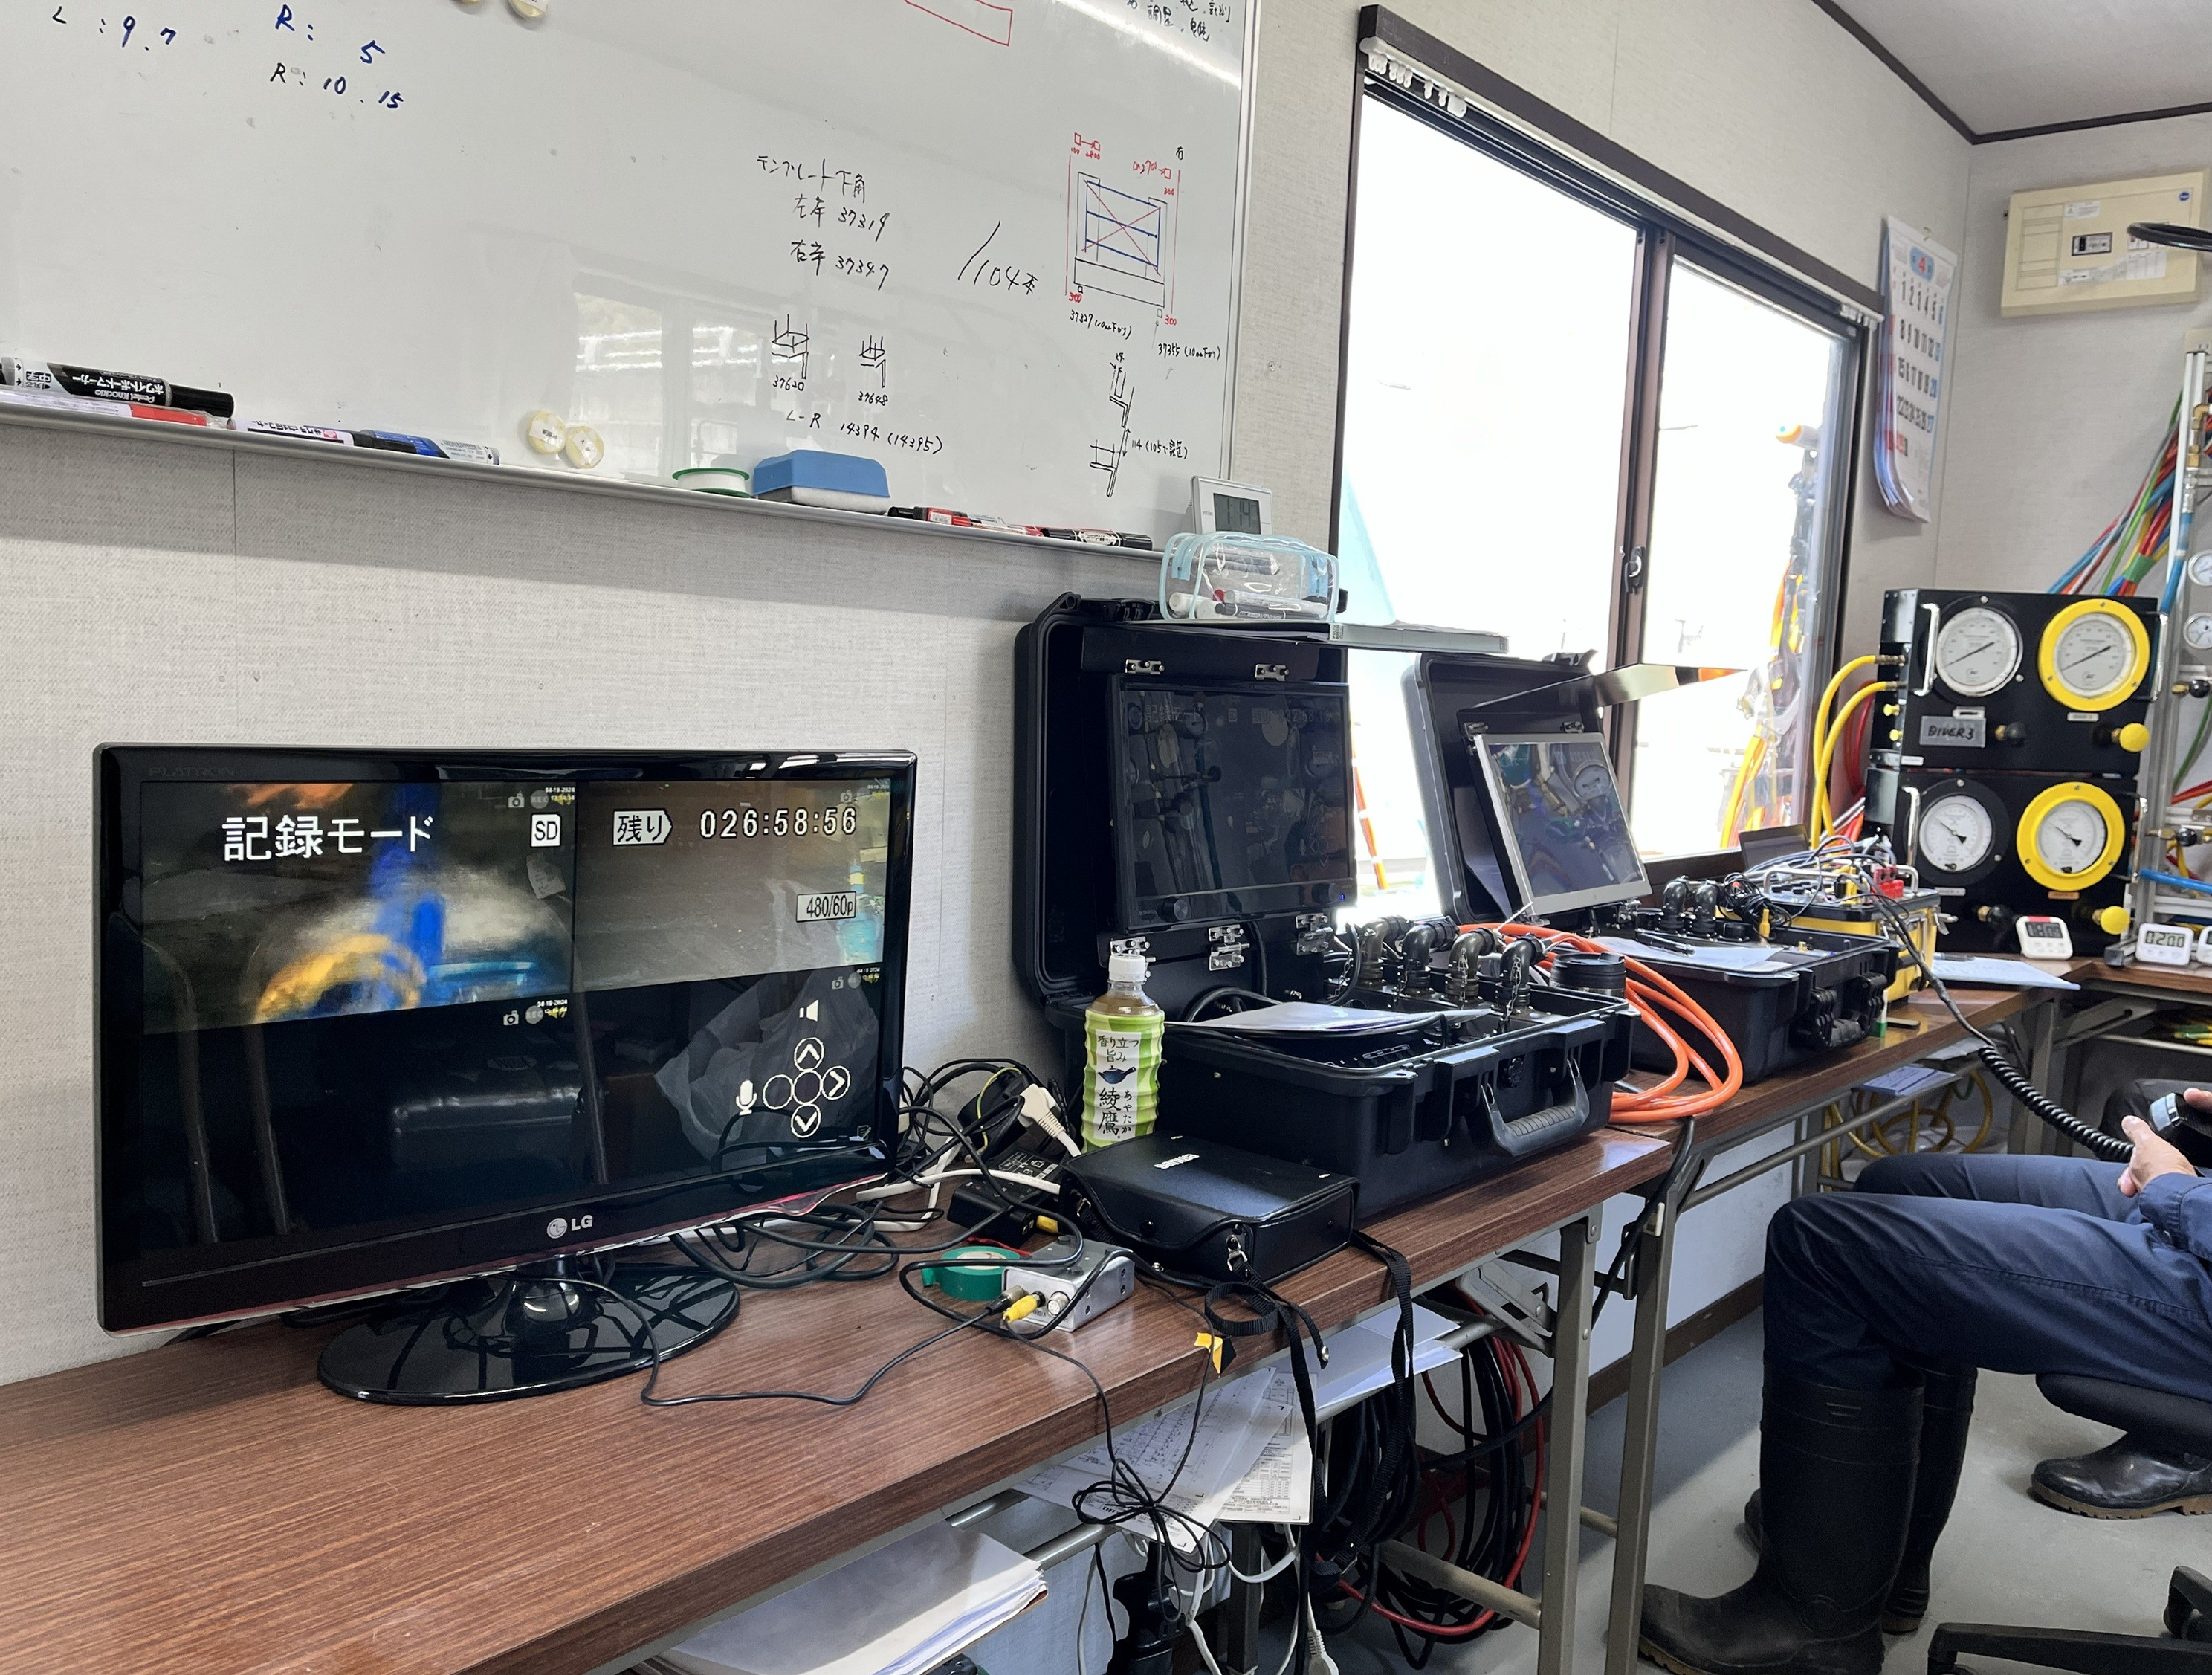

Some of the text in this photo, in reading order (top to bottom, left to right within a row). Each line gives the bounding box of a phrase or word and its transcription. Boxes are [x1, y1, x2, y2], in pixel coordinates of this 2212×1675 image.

[360, 39, 386, 64] 5
[838, 206, 890, 242] 37319
[1068, 291, 1083, 303] 300
[1164, 314, 1177, 326] 300
[72, 373, 165, 396] ホワイトボードマーカー
[772, 375, 805, 392] 37620
[858, 390, 889, 407] 37648
[1928, 725, 1975, 740] DIVER 3
[534, 821, 559, 842] SD
[616, 814, 665, 843] 残り
[699, 807, 858, 839] 026:58:56
[222, 814, 433, 862] 記録モード
[806, 894, 854, 920] 480/60p
[1098, 1035, 1140, 1049] 香り立つ
[1106, 1049, 1128, 1063] 旨み
[1099, 1087, 1122, 1137] 綾鷹
[1122, 1089, 1134, 1135] あやたか
[570, 1214, 594, 1232] LG
